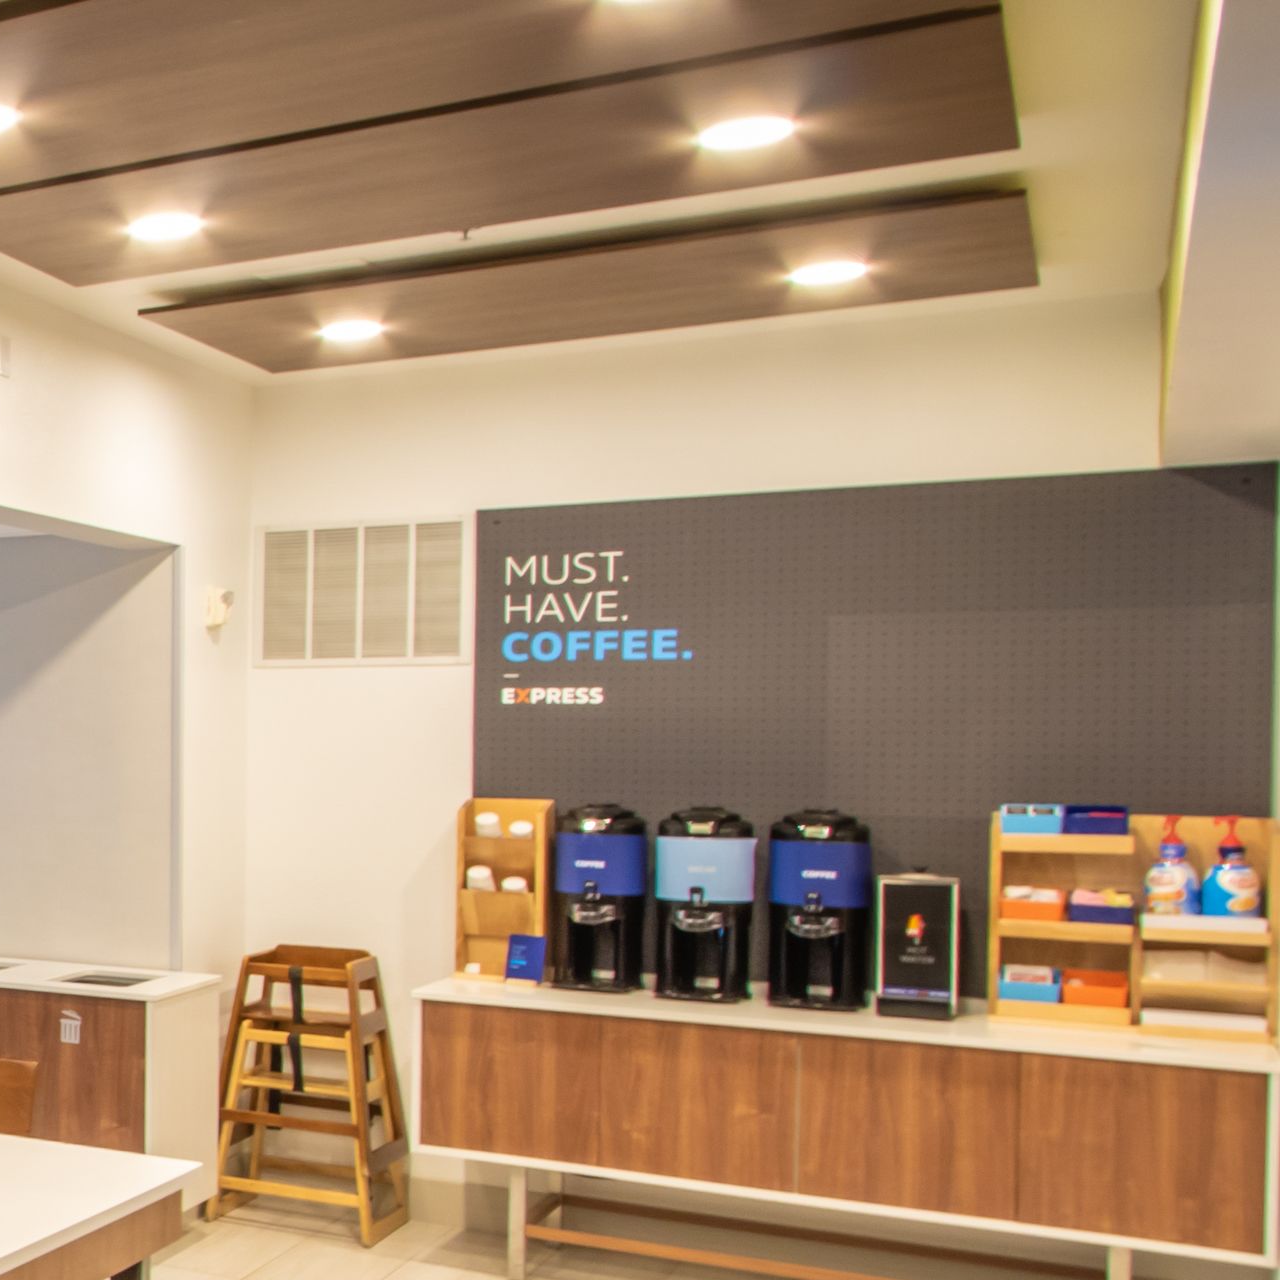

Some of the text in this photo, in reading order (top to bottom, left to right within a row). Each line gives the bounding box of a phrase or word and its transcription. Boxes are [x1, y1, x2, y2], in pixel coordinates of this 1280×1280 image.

[504, 551, 629, 586] MUST.
[504, 590, 629, 624] HAVE.
[501, 629, 693, 662] COFFEE.
[501, 686, 604, 705] EXPRESS
[801, 869, 838, 880] COFFEE
